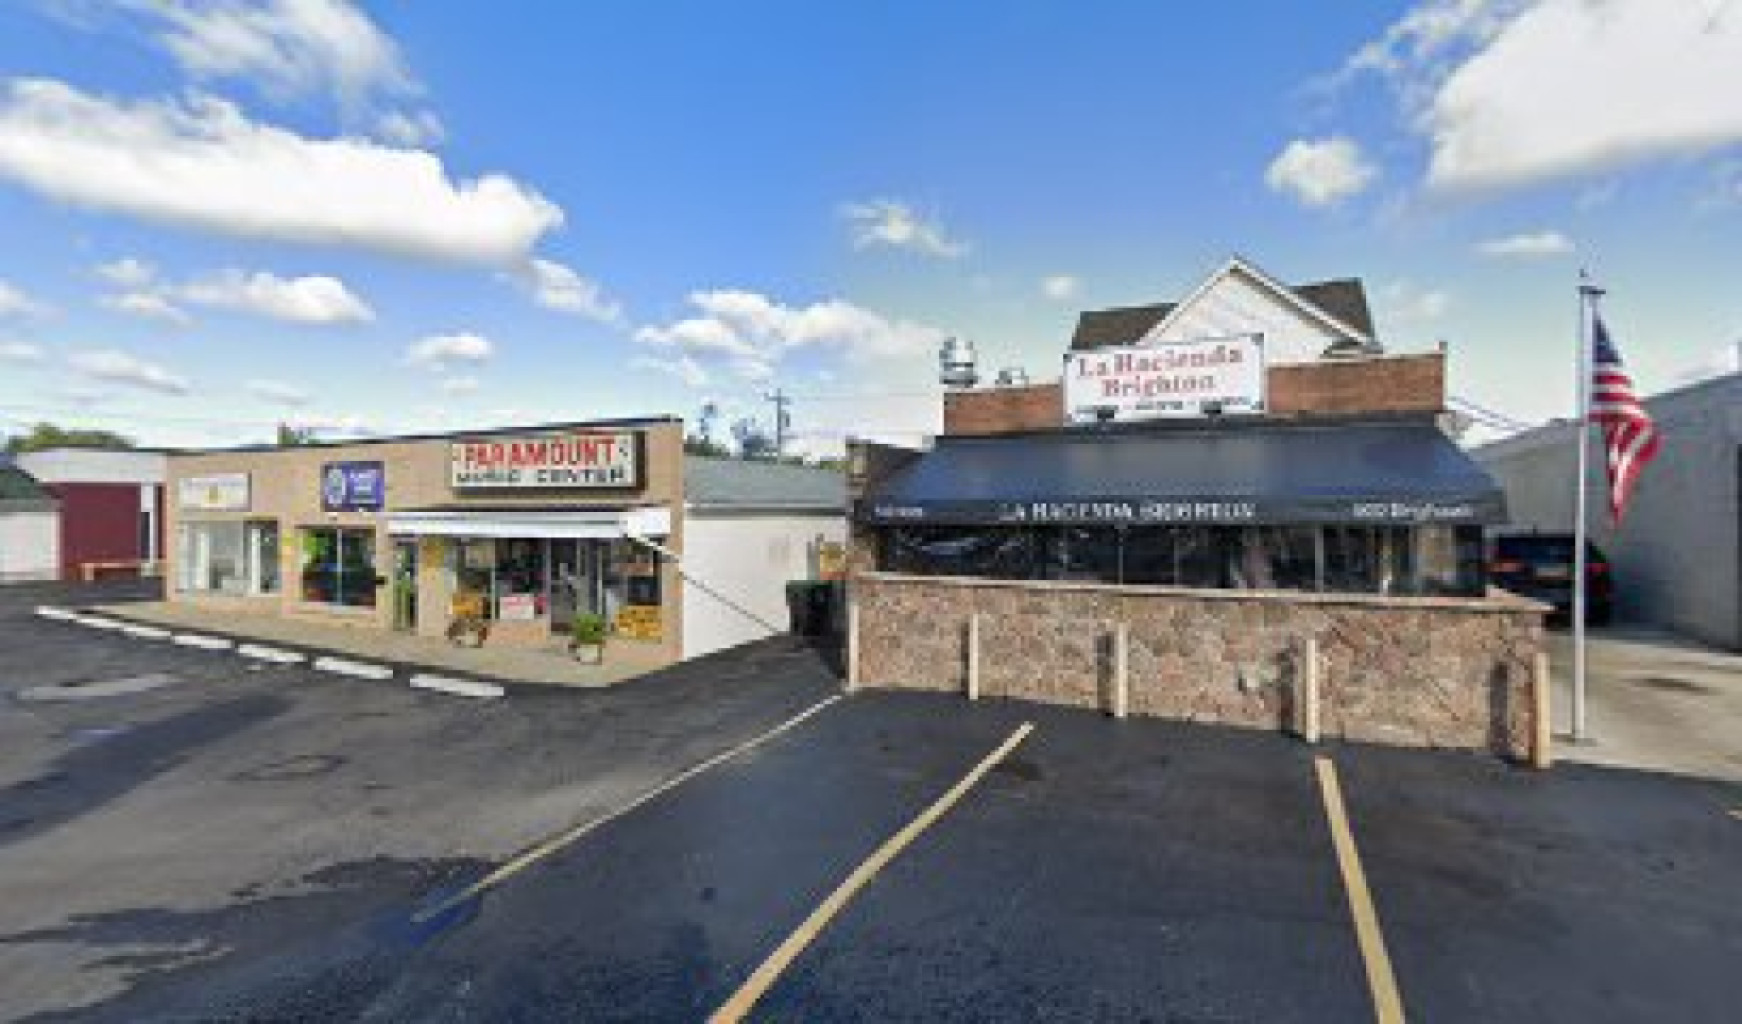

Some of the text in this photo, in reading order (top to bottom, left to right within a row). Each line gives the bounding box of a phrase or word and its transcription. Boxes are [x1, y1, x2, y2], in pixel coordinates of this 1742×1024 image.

[1079, 346, 1243, 378] La Hacienda
[1103, 376, 1216, 397] Brighton
[465, 437, 616, 468] PARAMOUNT
[537, 468, 624, 483] CENTER
